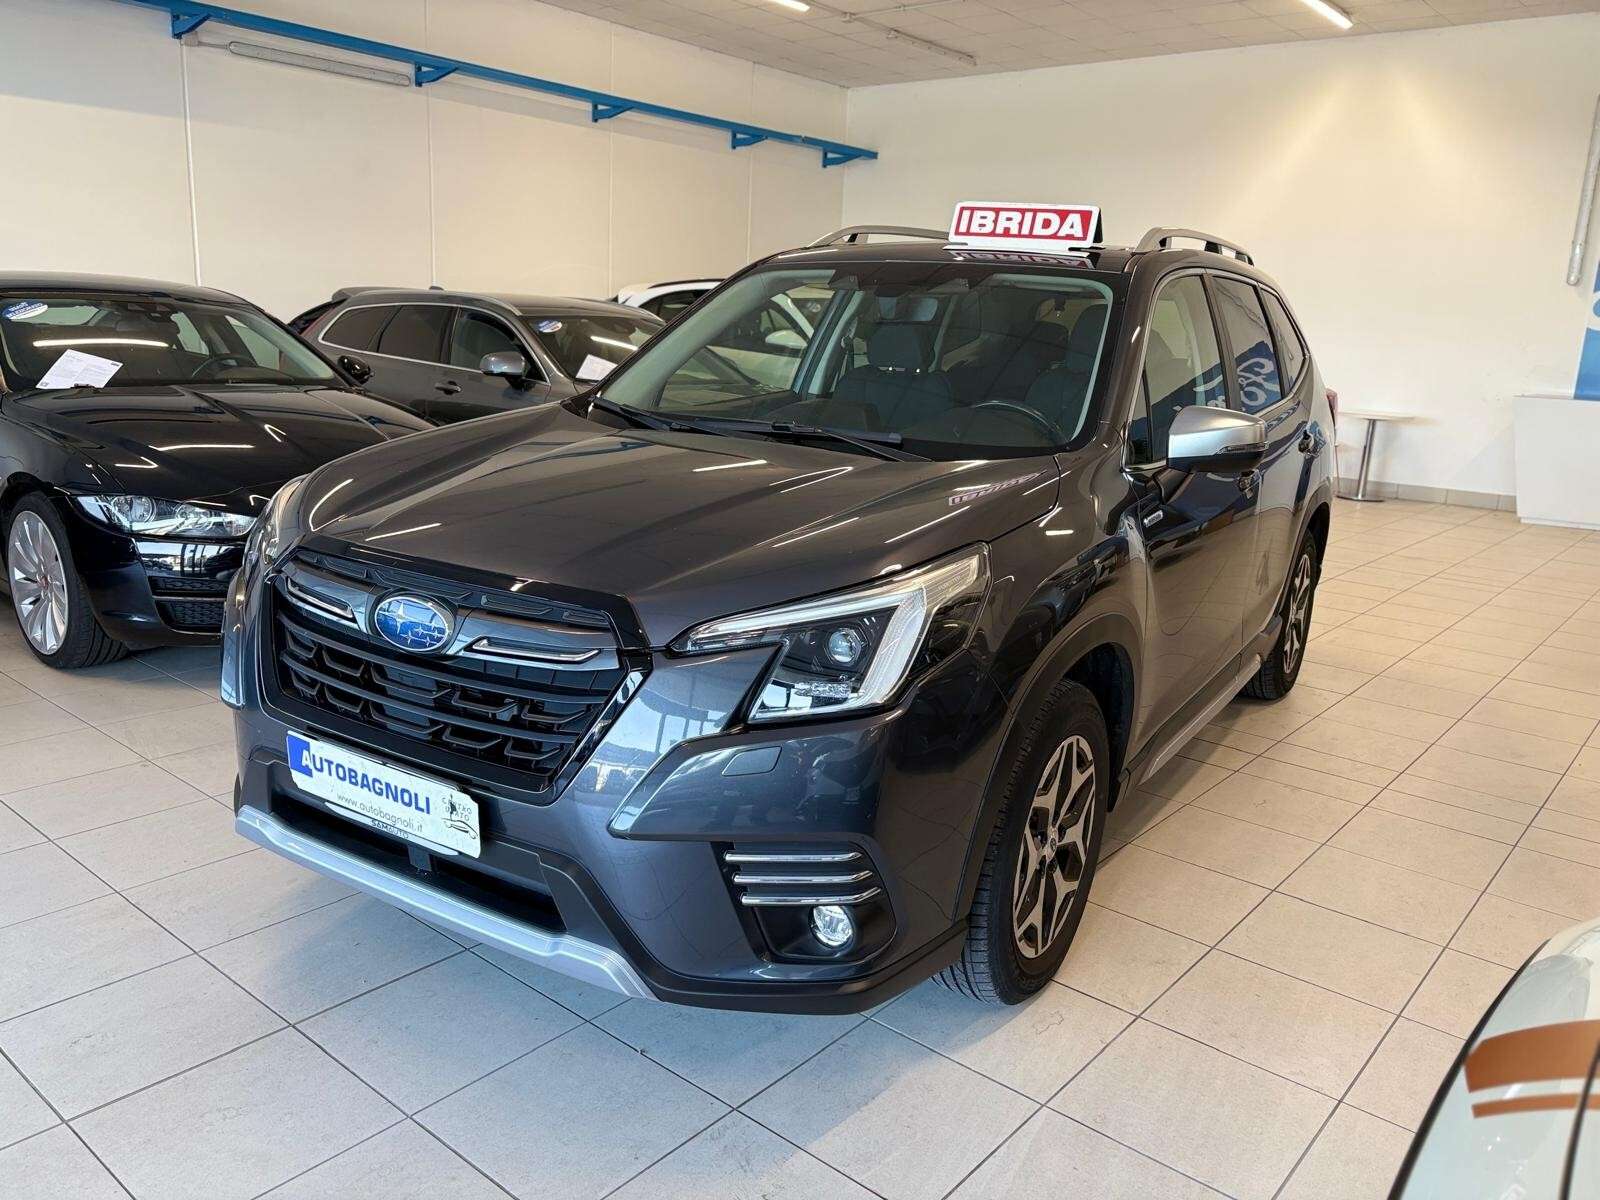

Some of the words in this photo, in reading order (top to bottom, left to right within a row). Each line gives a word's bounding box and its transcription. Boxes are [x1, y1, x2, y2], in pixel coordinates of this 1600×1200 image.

[958, 209, 1084, 238] IBRIDA
[301, 749, 431, 815] AUTOBAGNOLI
[336, 794, 423, 832] www.autobagnoli.it
